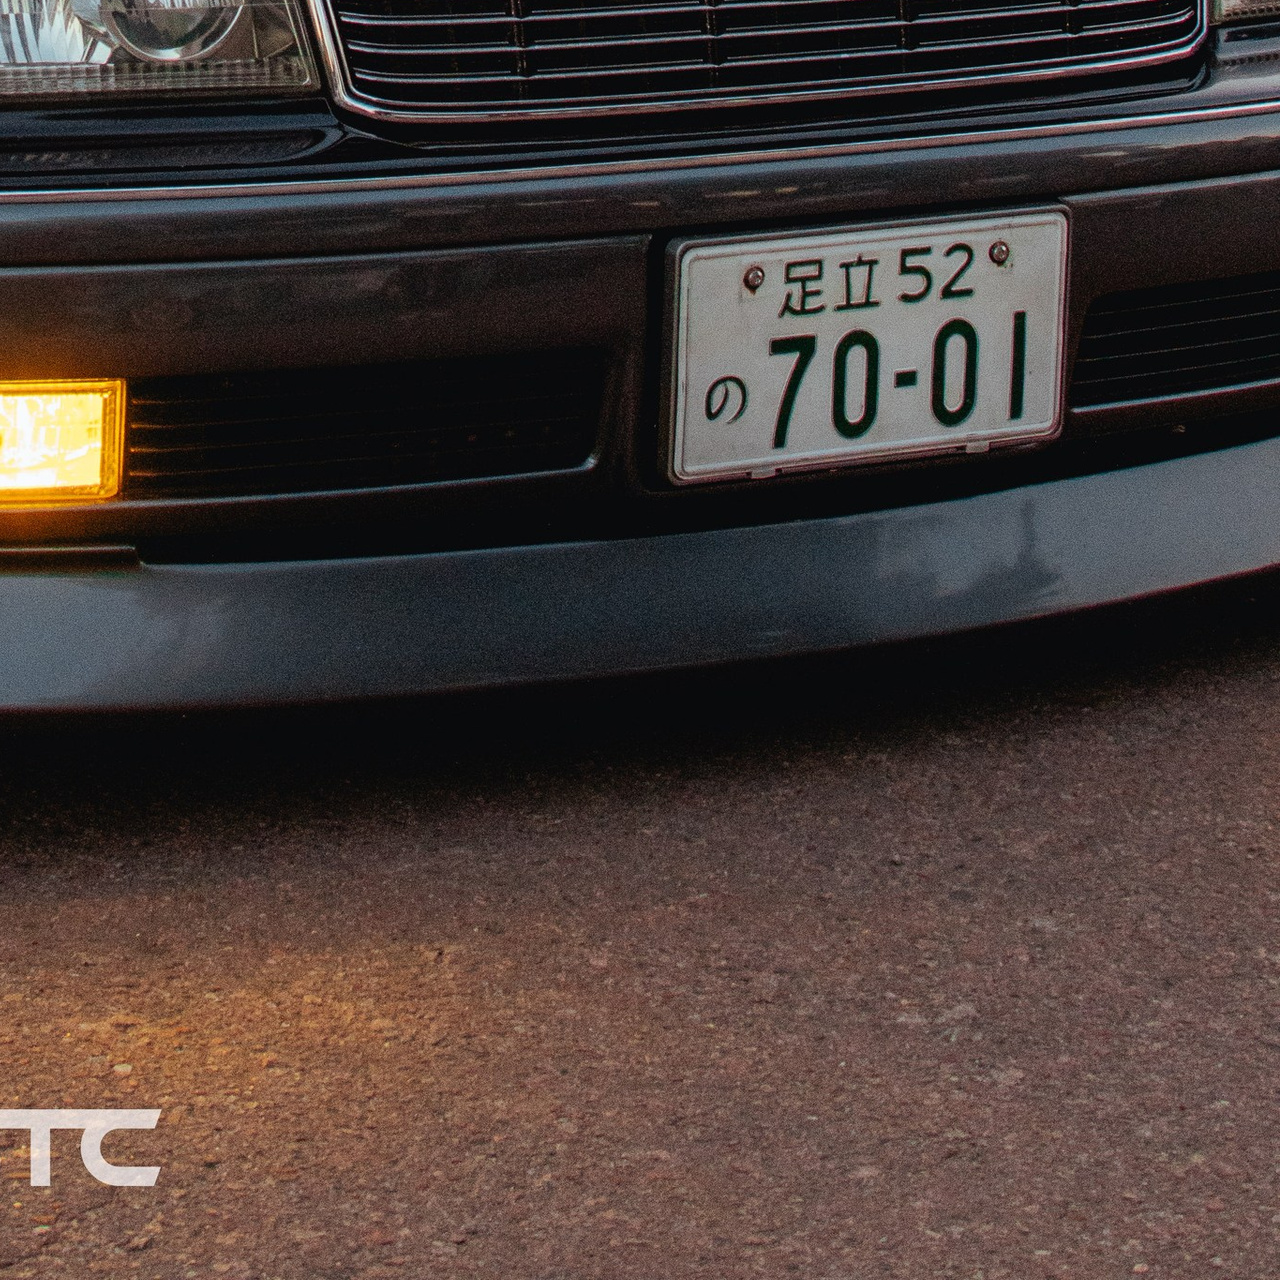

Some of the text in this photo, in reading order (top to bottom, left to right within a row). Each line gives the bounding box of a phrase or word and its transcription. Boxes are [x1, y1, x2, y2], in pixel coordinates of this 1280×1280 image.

[778, 242, 975, 318] 足立 52
[705, 309, 1028, 449] の 70-01
